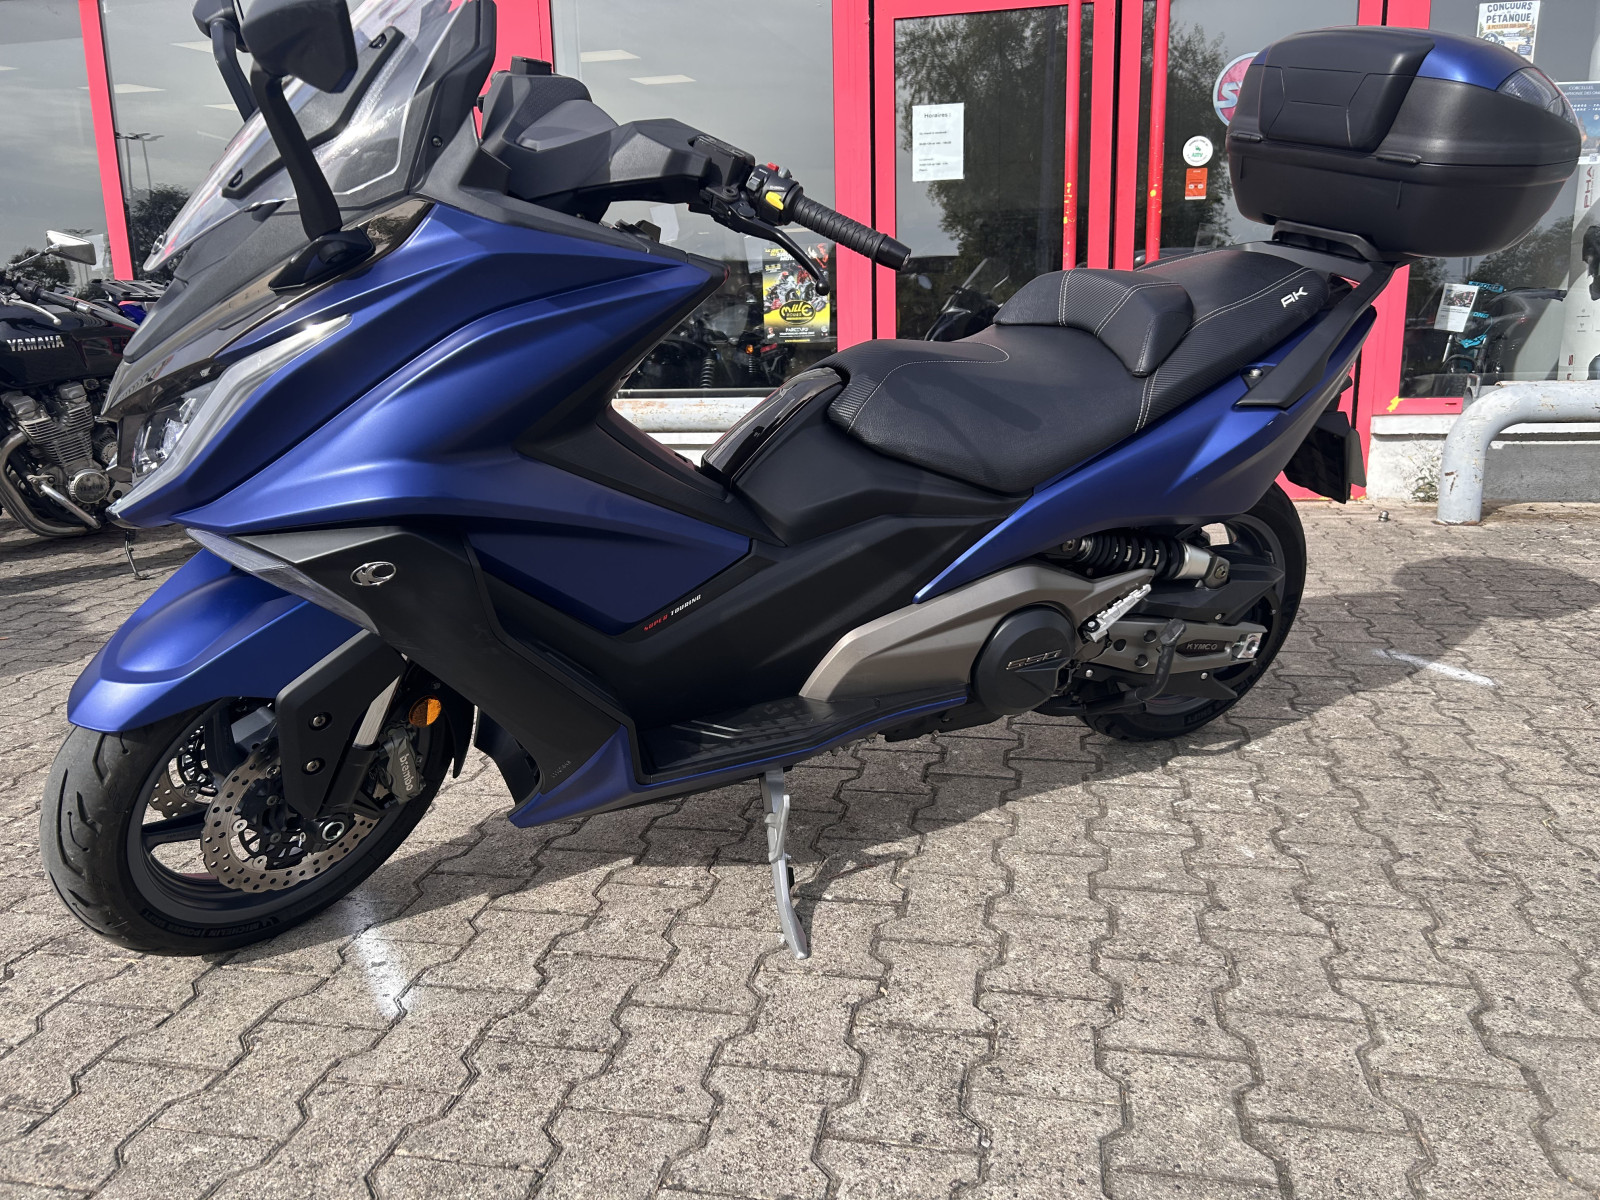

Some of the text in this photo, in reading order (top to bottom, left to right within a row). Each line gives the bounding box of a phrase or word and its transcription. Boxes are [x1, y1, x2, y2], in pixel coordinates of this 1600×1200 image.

[1487, 1, 1533, 13] CONCOURS
[1486, 12, 1532, 24] PÉTANQUE
[1280, 286, 1308, 308] AK
[7, 335, 64, 352] YAMAHA
[670, 594, 701, 616] TOURING
[1186, 643, 1218, 651] KYMCO
[399, 753, 414, 791] brembo
[208, 922, 260, 937] MICHELIN
